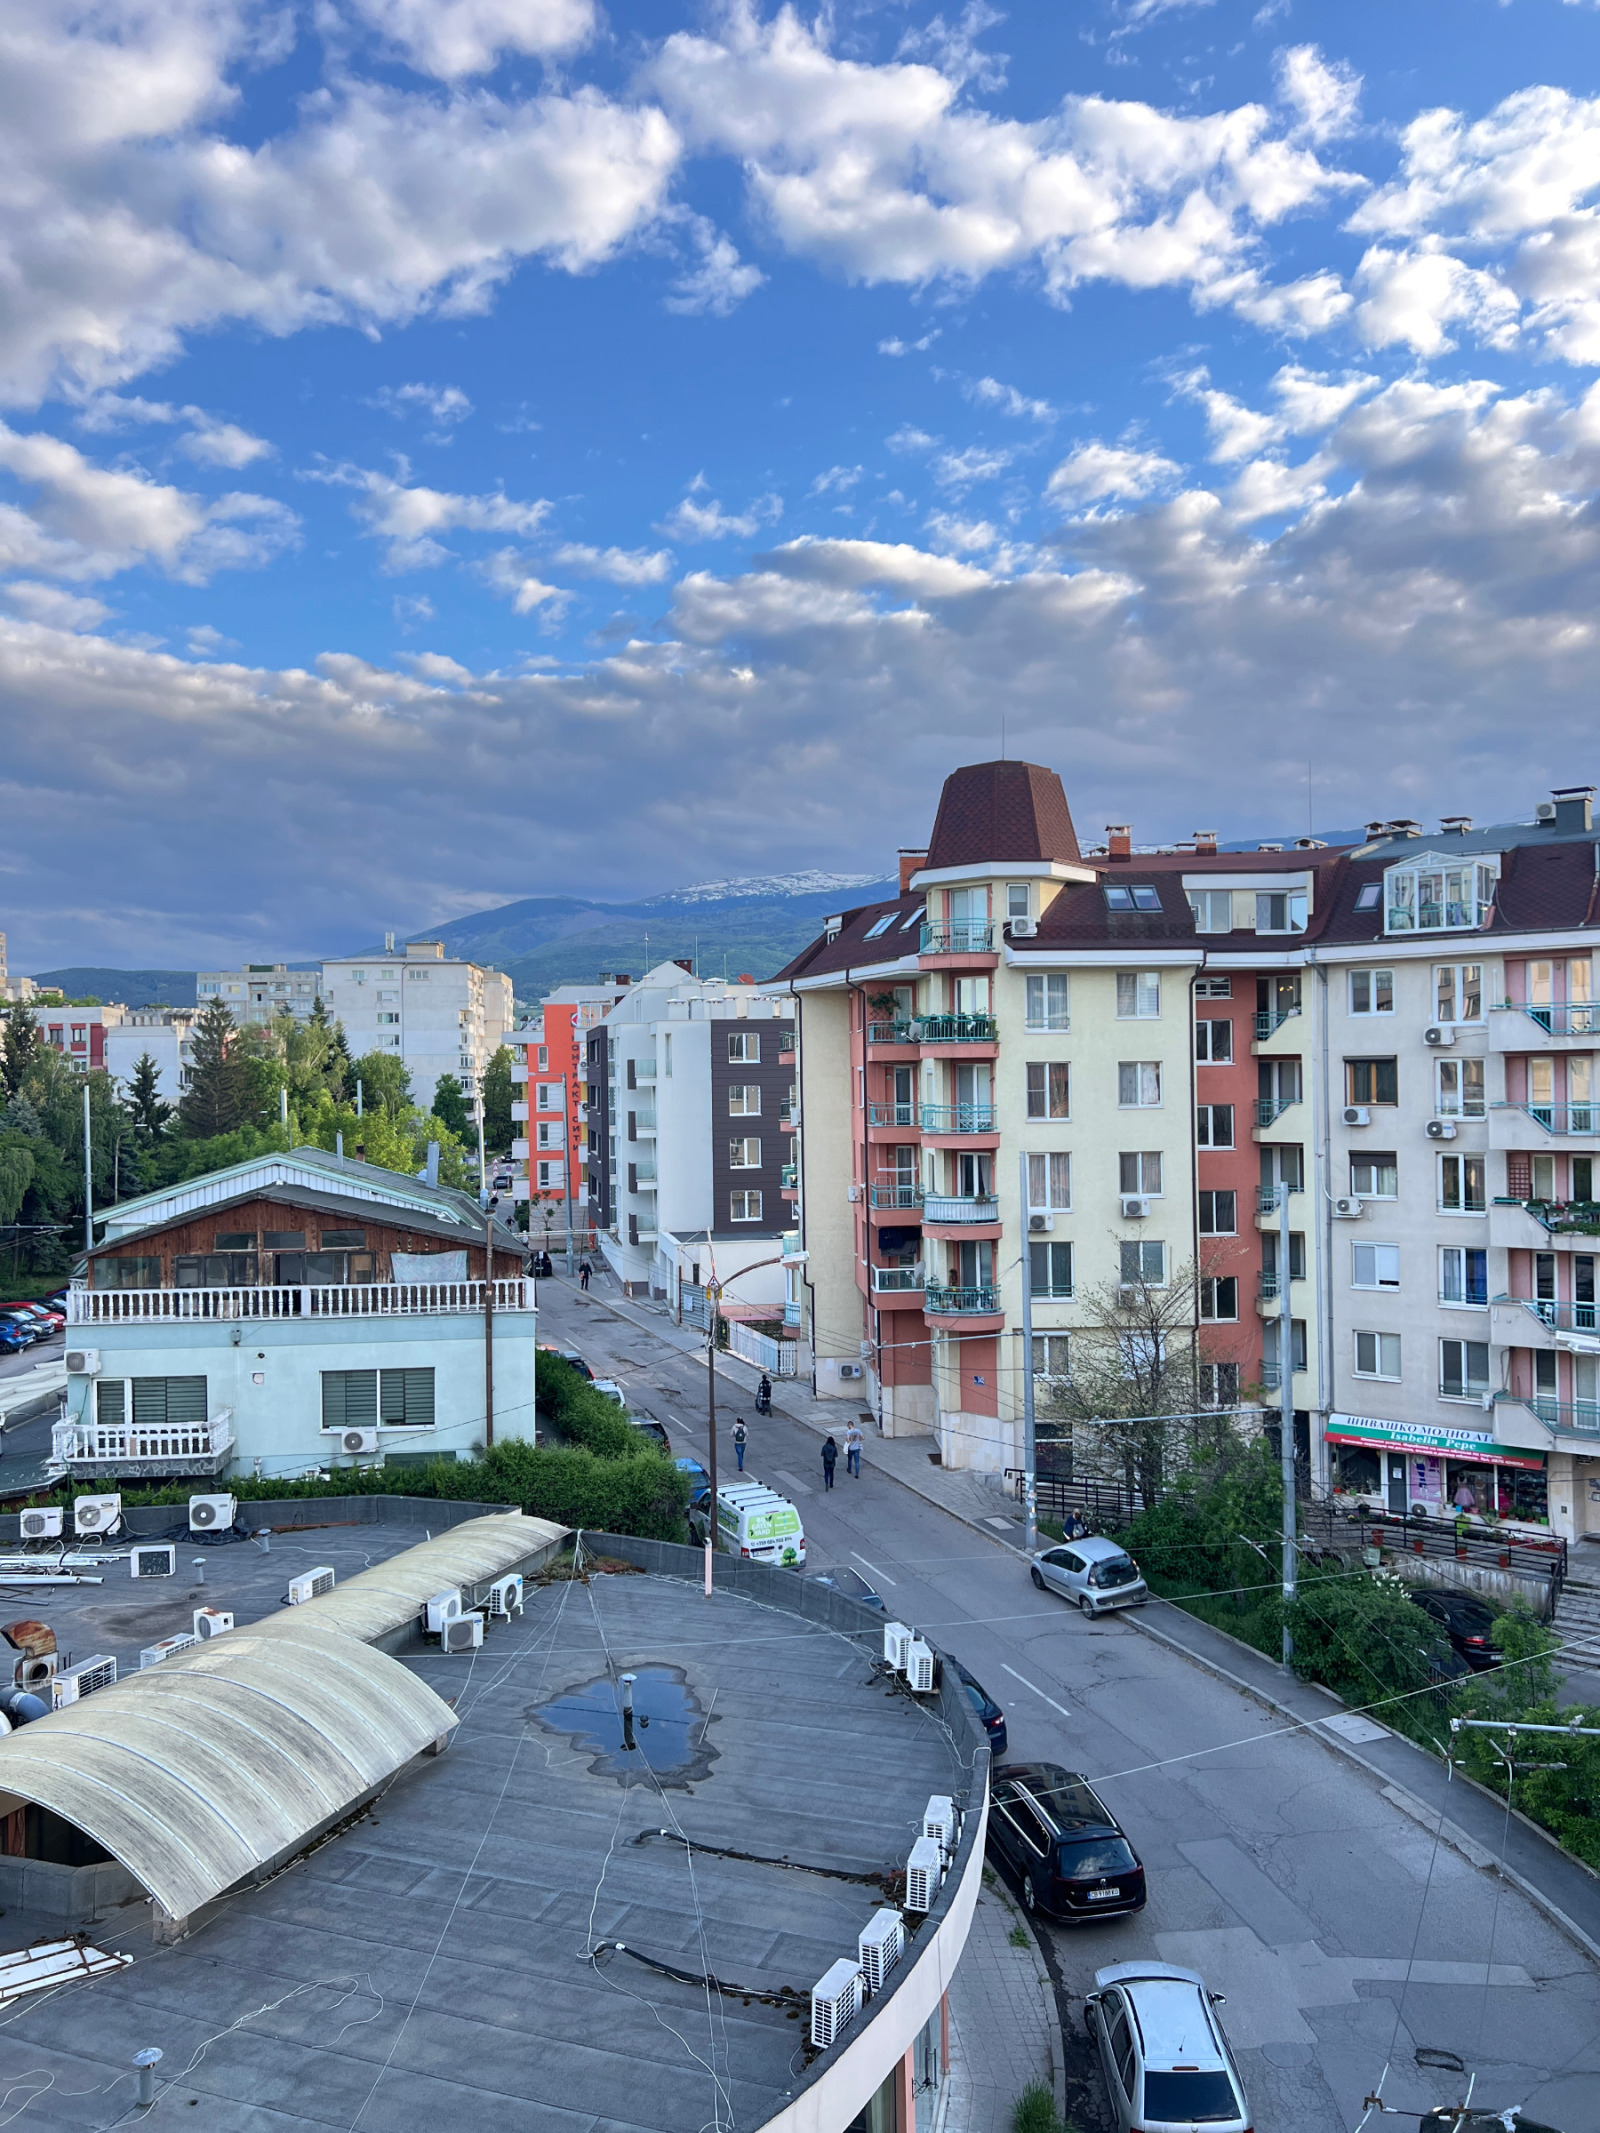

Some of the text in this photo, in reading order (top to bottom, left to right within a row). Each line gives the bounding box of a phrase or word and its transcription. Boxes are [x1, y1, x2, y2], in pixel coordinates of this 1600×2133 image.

[1347, 1417, 1417, 1433] ШИВАШКО
[1420, 1426, 1470, 1441] МОДНО
[1390, 1431, 1438, 1446] Isabella
[1445, 1438, 1476, 1451] Pepe
[751, 1521, 772, 1531] GREEN
[754, 1528, 771, 1536] YARD
